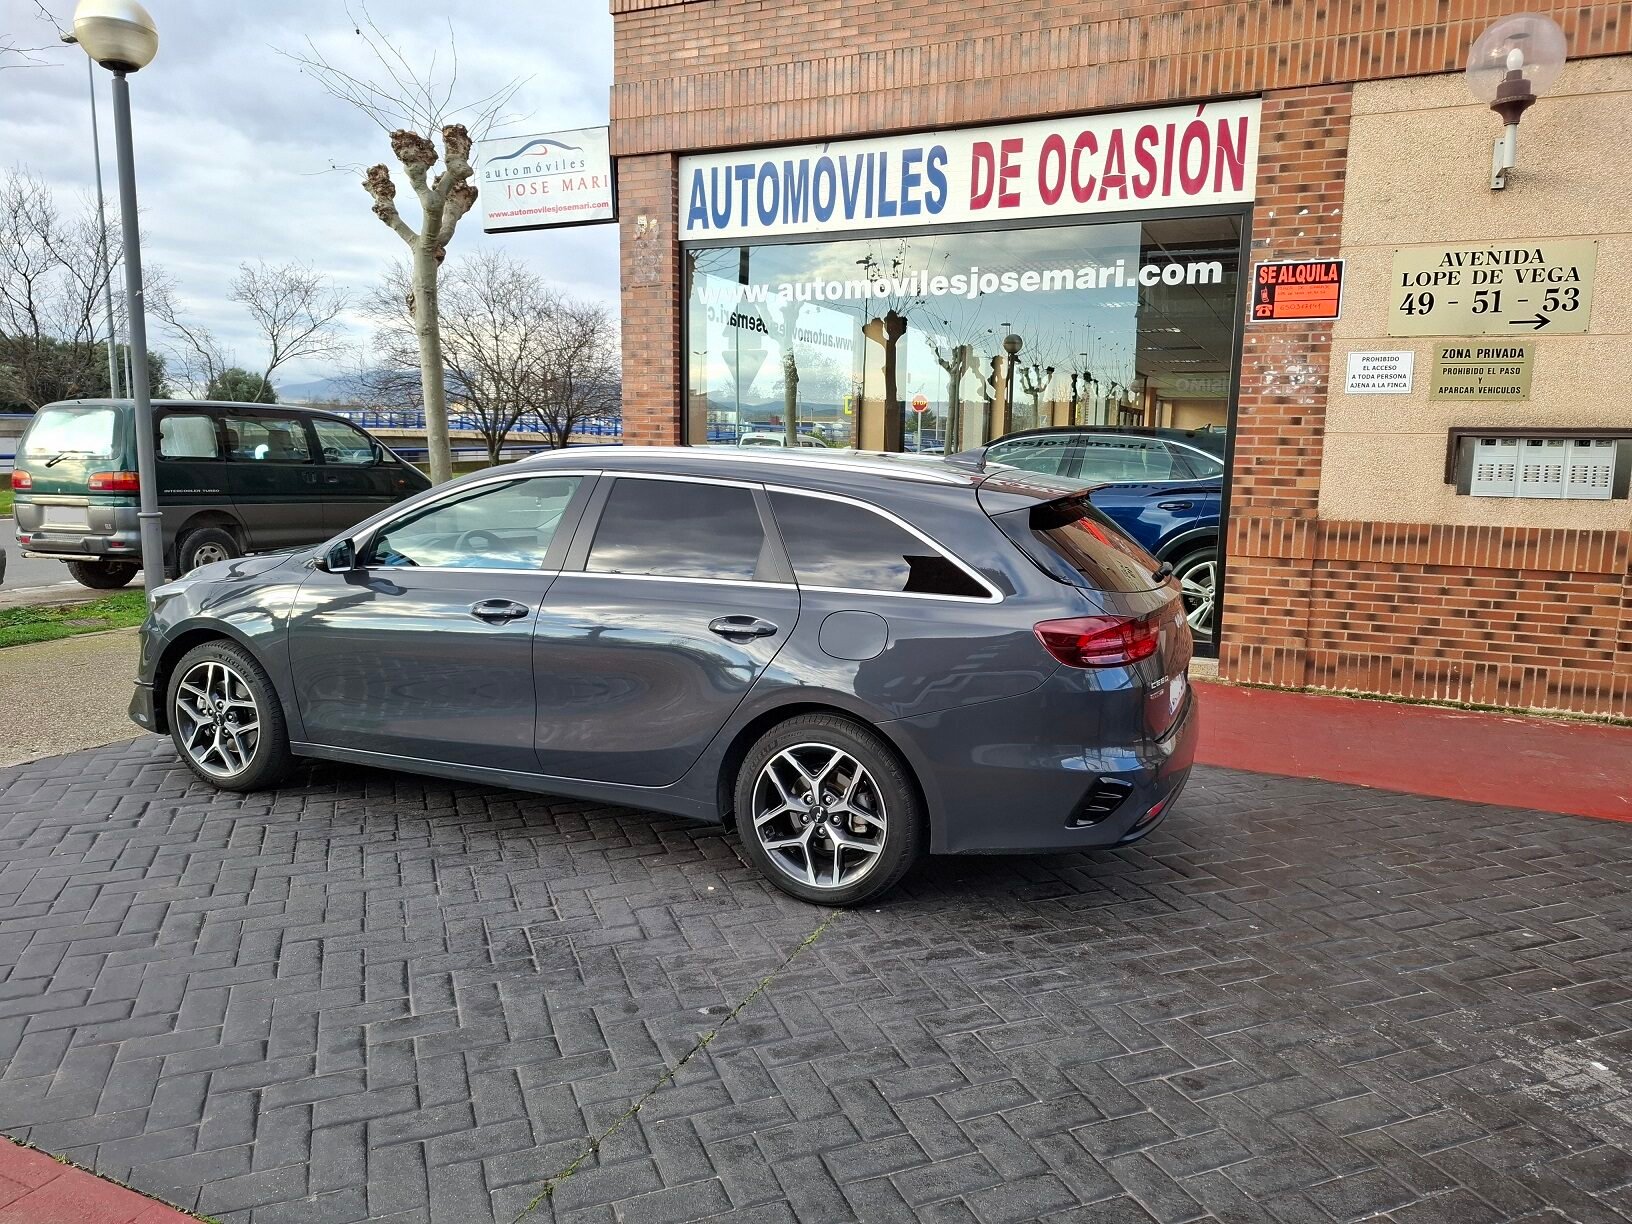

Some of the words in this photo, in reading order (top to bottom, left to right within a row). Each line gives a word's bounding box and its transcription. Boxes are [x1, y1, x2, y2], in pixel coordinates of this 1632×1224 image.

[485, 158, 585, 179] automóviles
[686, 142, 948, 231] AUTOMÓVILES
[970, 138, 1024, 210] DE
[1038, 103, 1248, 205] OCASIÓN
[507, 181, 550, 199] JOSE
[562, 174, 609, 192] MARI
[488, 201, 609, 219] www.automovilesjosemari.com
[1439, 249, 1545, 268] AVENIDA
[697, 259, 1224, 306] wwwautomovilesjosemari.com
[1259, 266, 1277, 284] SE
[1278, 263, 1338, 283] ALQUILA
[1401, 270, 1461, 288] LOPE
[1472, 269, 1503, 285] DE
[1515, 266, 1581, 283] VEGA
[1400, 291, 1435, 316] 49
[1471, 290, 1503, 314] 51
[1542, 287, 1580, 312] 53
[1442, 348, 1471, 359] ZONA
[1476, 348, 1525, 358] PRIVADA
[1442, 367, 1484, 375] PROHIBIDO
[1487, 367, 1497, 375] EL
[1500, 367, 1521, 375] PASO
[1438, 386, 1475, 394] APARCAR
[1478, 386, 1521, 394] VEHICULOS
